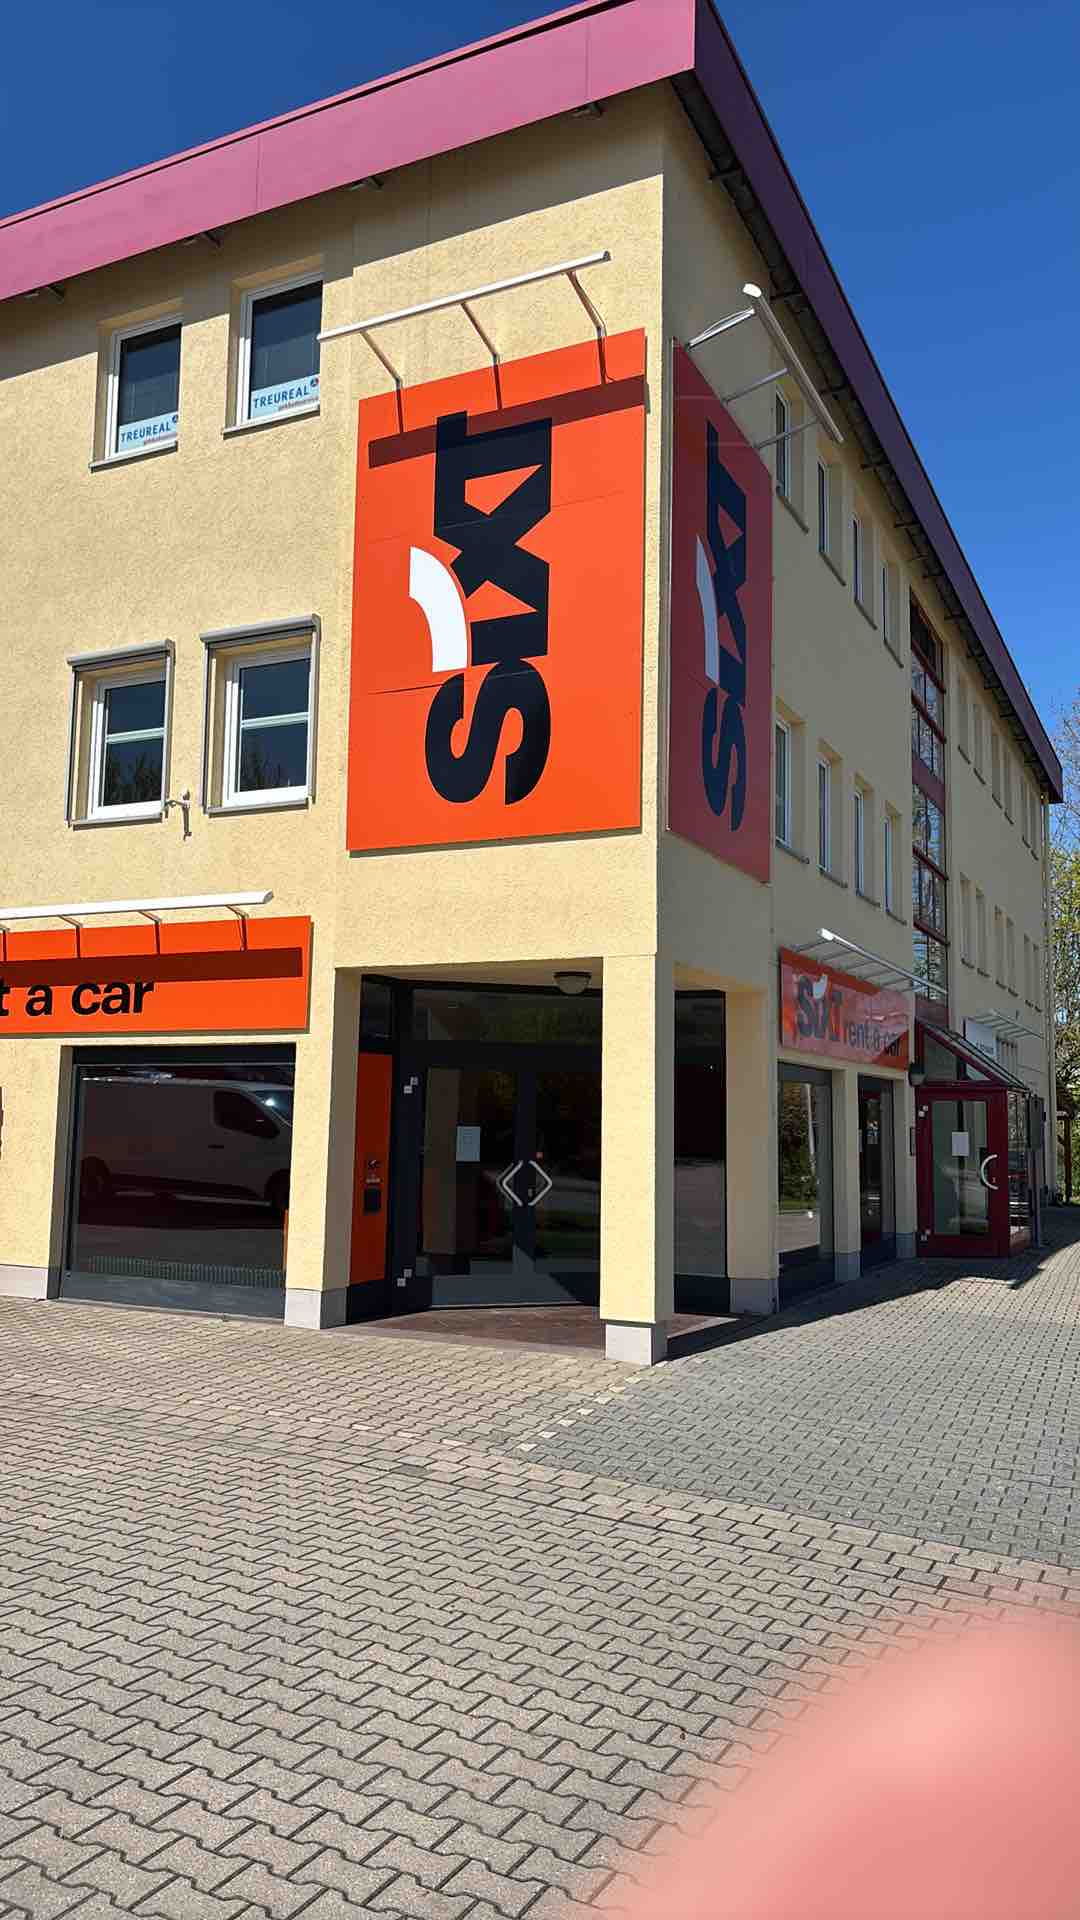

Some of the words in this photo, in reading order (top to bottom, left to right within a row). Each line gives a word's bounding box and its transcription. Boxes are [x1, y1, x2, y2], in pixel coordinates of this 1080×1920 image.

[254, 384, 309, 408] TREUREAL
[120, 422, 171, 442] TREUREAL
[423, 410, 553, 806] SIXT
[699, 420, 747, 833] SIXT
[25, 984, 53, 1016] a
[71, 980, 155, 1016] car
[797, 973, 843, 1041] SIXT
